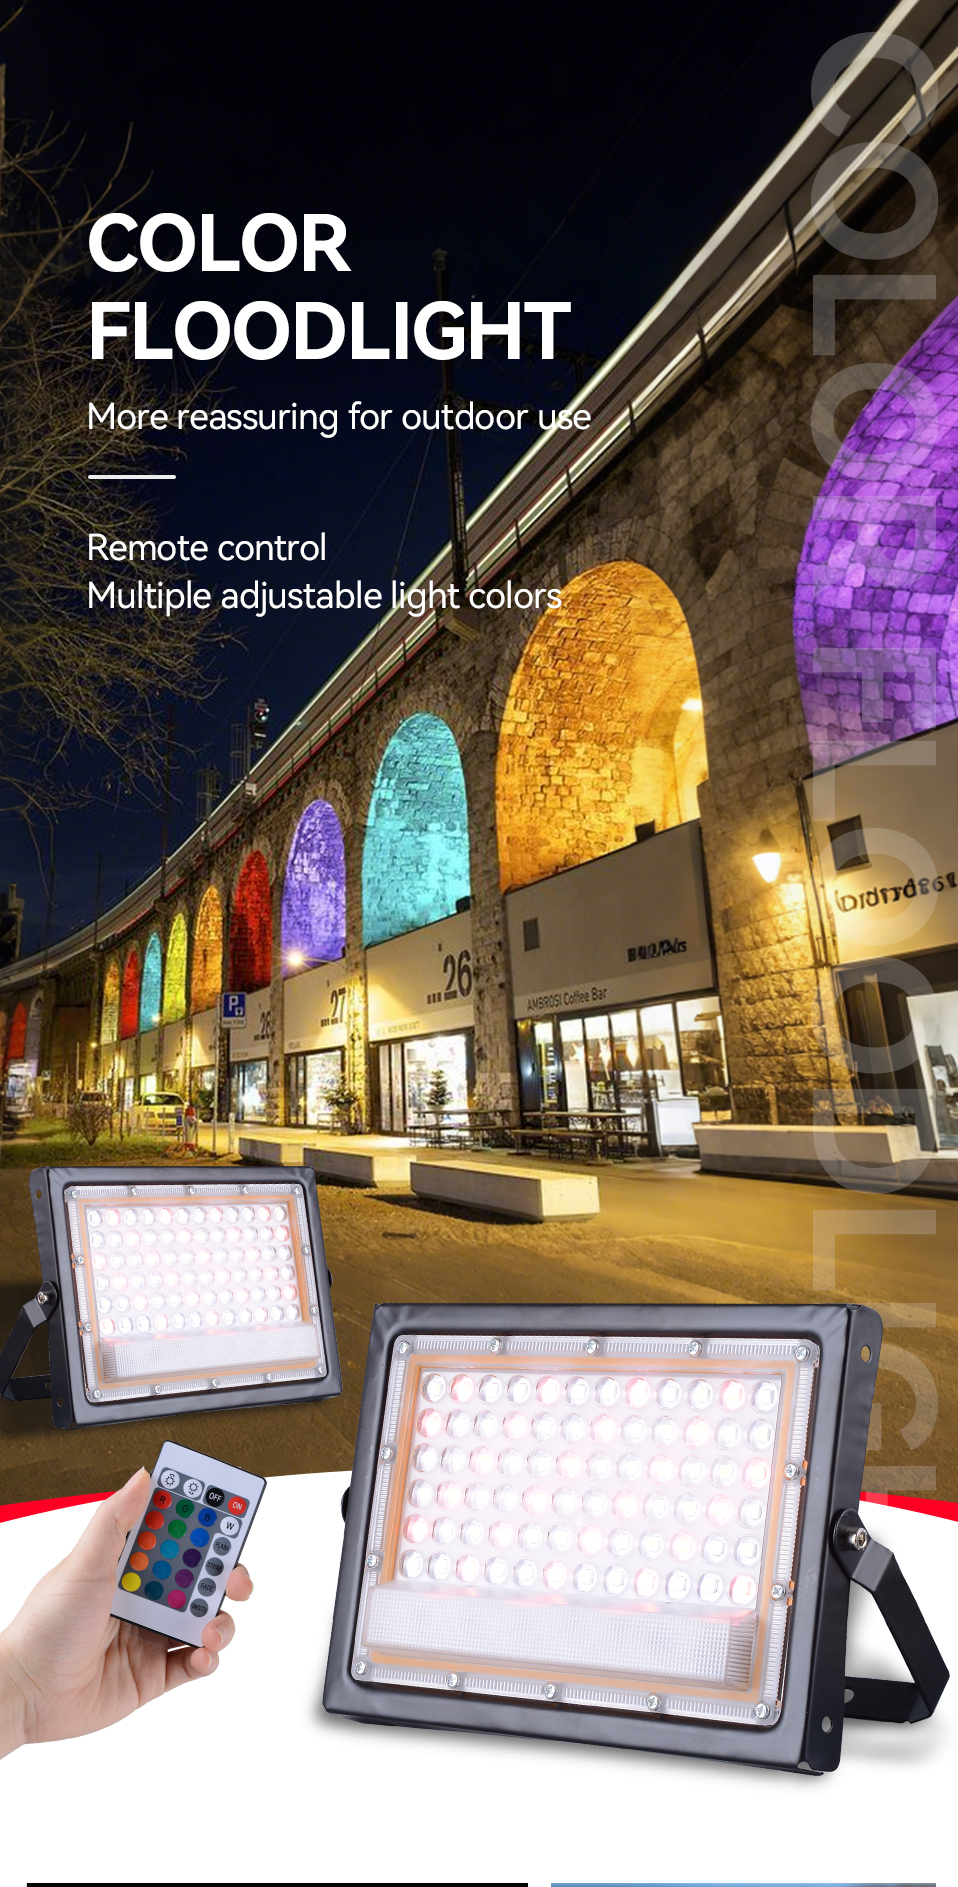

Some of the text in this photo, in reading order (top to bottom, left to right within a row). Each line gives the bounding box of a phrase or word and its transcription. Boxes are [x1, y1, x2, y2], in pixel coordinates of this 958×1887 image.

[443, 950, 472, 999] 26
[229, 996, 239, 1011] P
[563, 990, 590, 1006] Coffee
[591, 987, 607, 1001] Bar
[208, 1492, 243, 1511] OFF ON
[159, 1495, 235, 1531] R G B W
[215, 1541, 229, 1552] FLASH
[200, 1582, 214, 1593] FADE
